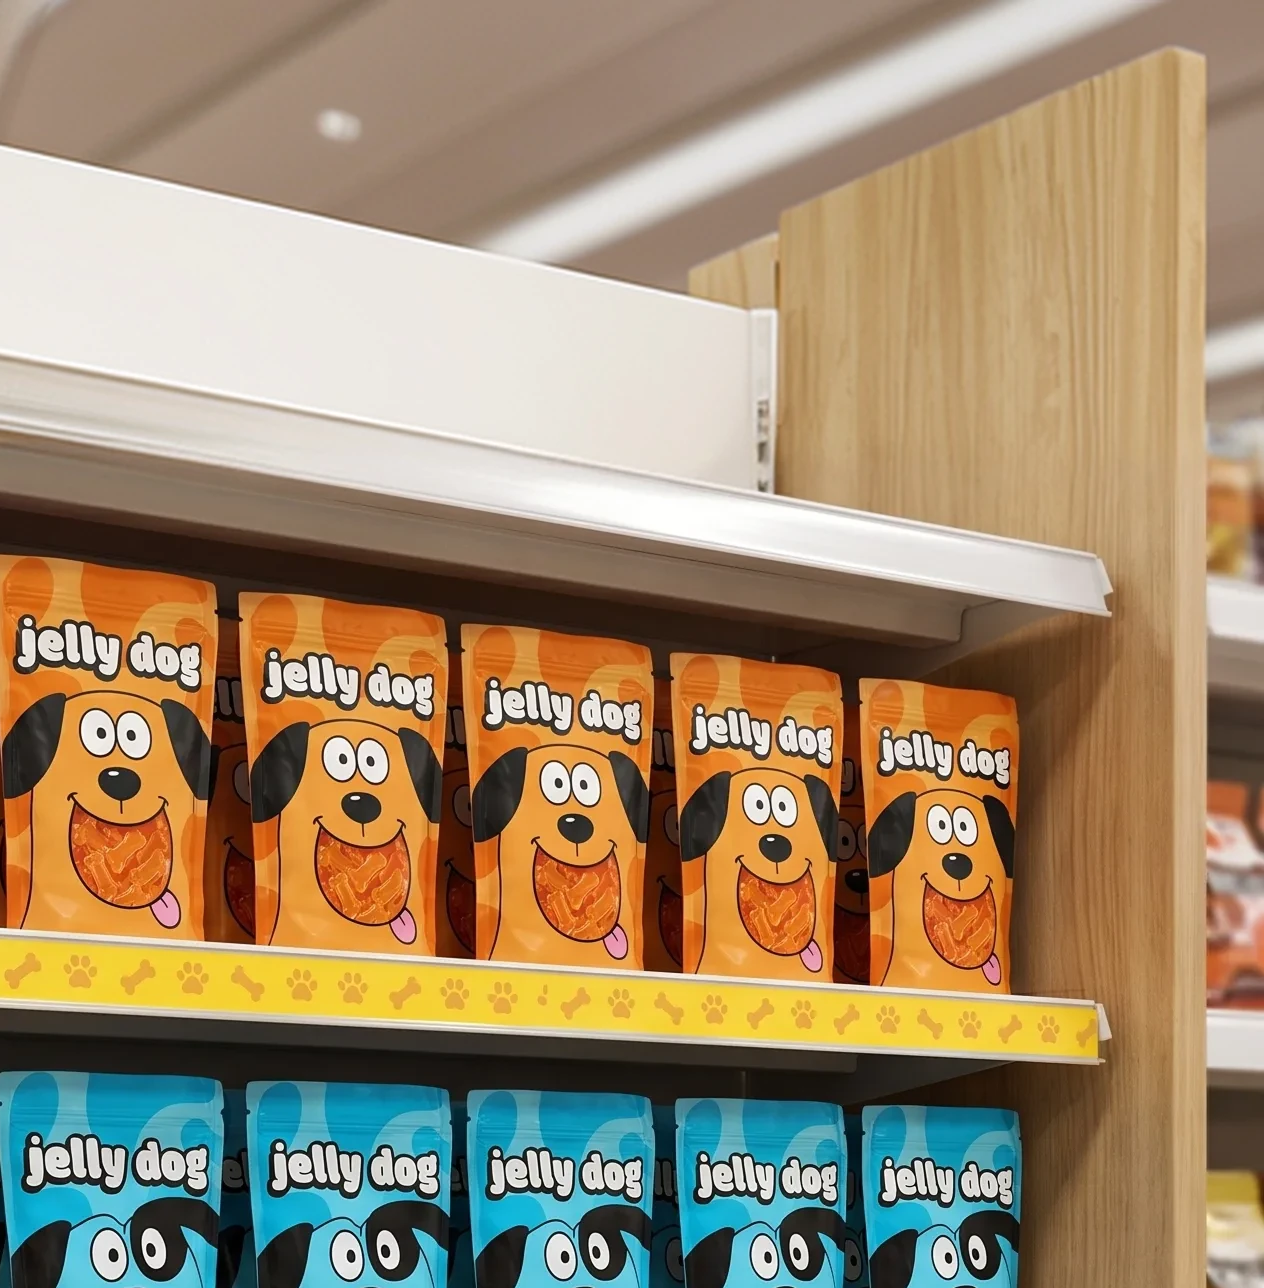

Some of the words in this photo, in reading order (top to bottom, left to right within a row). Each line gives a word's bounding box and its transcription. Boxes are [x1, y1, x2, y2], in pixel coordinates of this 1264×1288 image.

[15, 615, 122, 678] jelly
[127, 632, 202, 689] dog
[262, 649, 361, 708] jelly
[366, 663, 435, 718] dog
[483, 677, 575, 733] jelly
[578, 690, 643, 743] dog
[690, 704, 773, 758] jelly
[776, 716, 834, 767] dog
[878, 727, 955, 779] jelly
[957, 739, 1011, 787] dog
[24, 1133, 128, 1191] jelly
[133, 1139, 210, 1192] dog
[269, 1139, 364, 1195] jelly
[368, 1145, 441, 1196] dog
[487, 1146, 576, 1199] jelly
[579, 1151, 644, 1201] dog
[695, 1151, 777, 1202] jelly
[779, 1156, 840, 1204] dog
[879, 1157, 956, 1206] jelly
[958, 1161, 1015, 1207] dog
